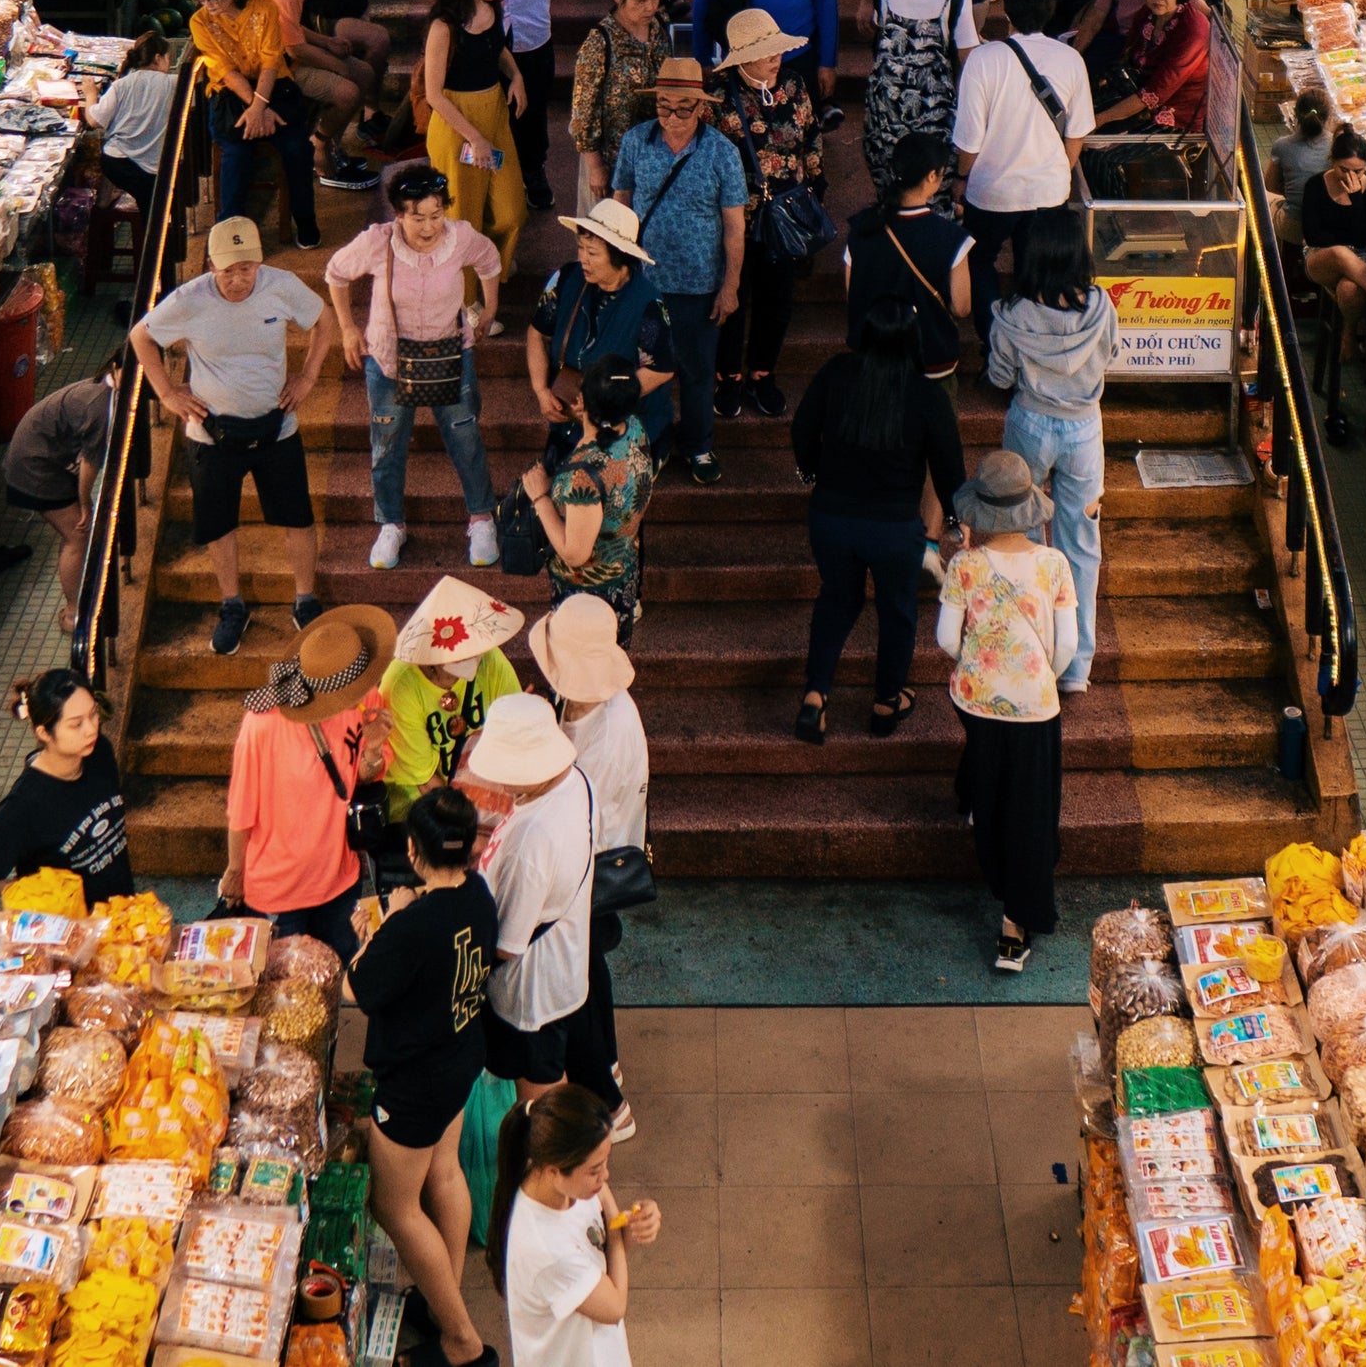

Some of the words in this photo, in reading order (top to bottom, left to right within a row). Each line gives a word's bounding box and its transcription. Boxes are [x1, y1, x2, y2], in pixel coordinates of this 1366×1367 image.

[1207, 316, 1233, 327] ngon!
[1136, 332, 1163, 349] ĐỐI
[1168, 333, 1221, 349] CHỨNG
[1126, 352, 1165, 367] (MIỄN
[1168, 355, 1195, 367] PHÍ)
